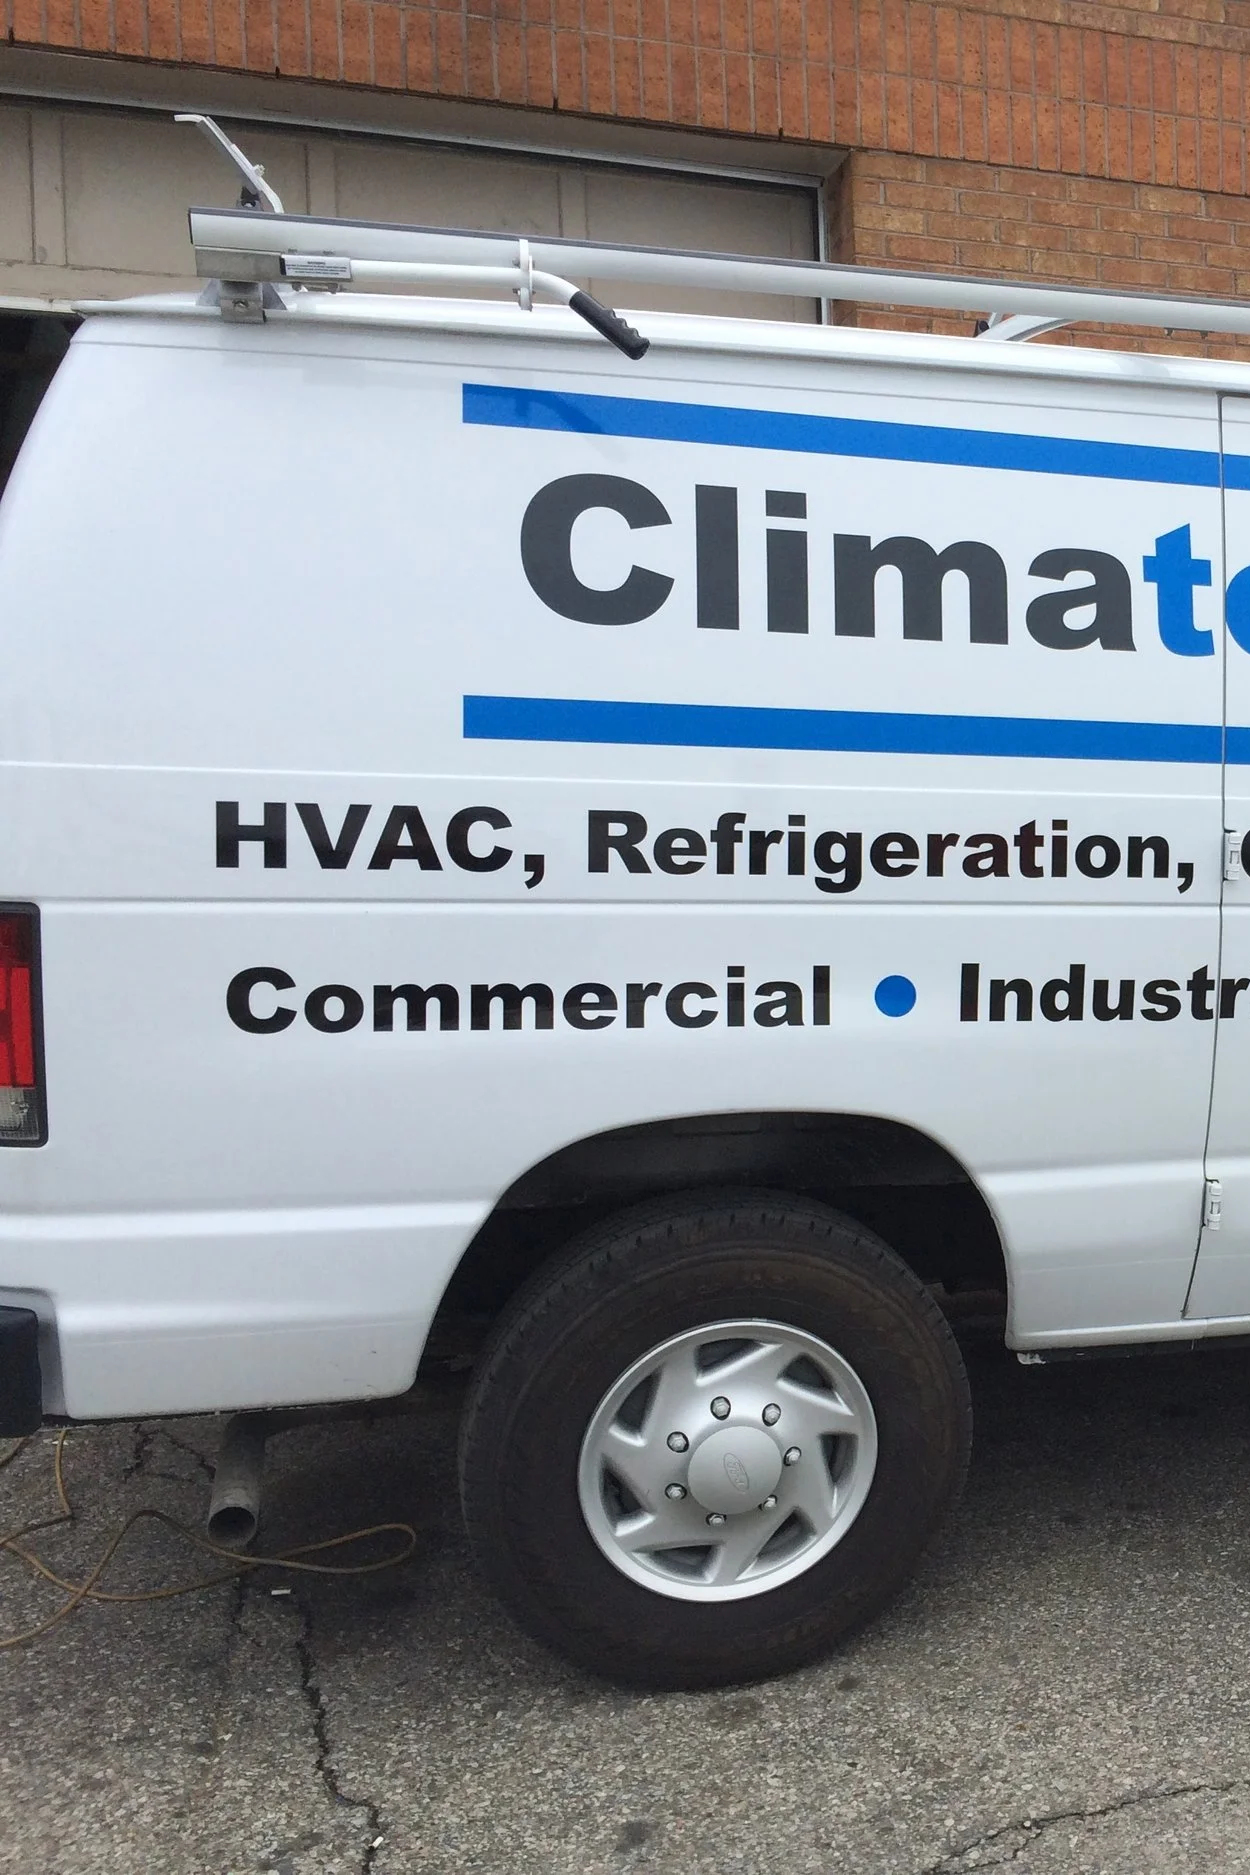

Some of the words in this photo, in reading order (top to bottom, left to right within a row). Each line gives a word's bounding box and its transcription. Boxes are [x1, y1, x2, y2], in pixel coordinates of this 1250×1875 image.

[215, 800, 546, 890] HVAC,
[587, 809, 1195, 894] Refrigeration,
[226, 965, 831, 1035] Commercial
